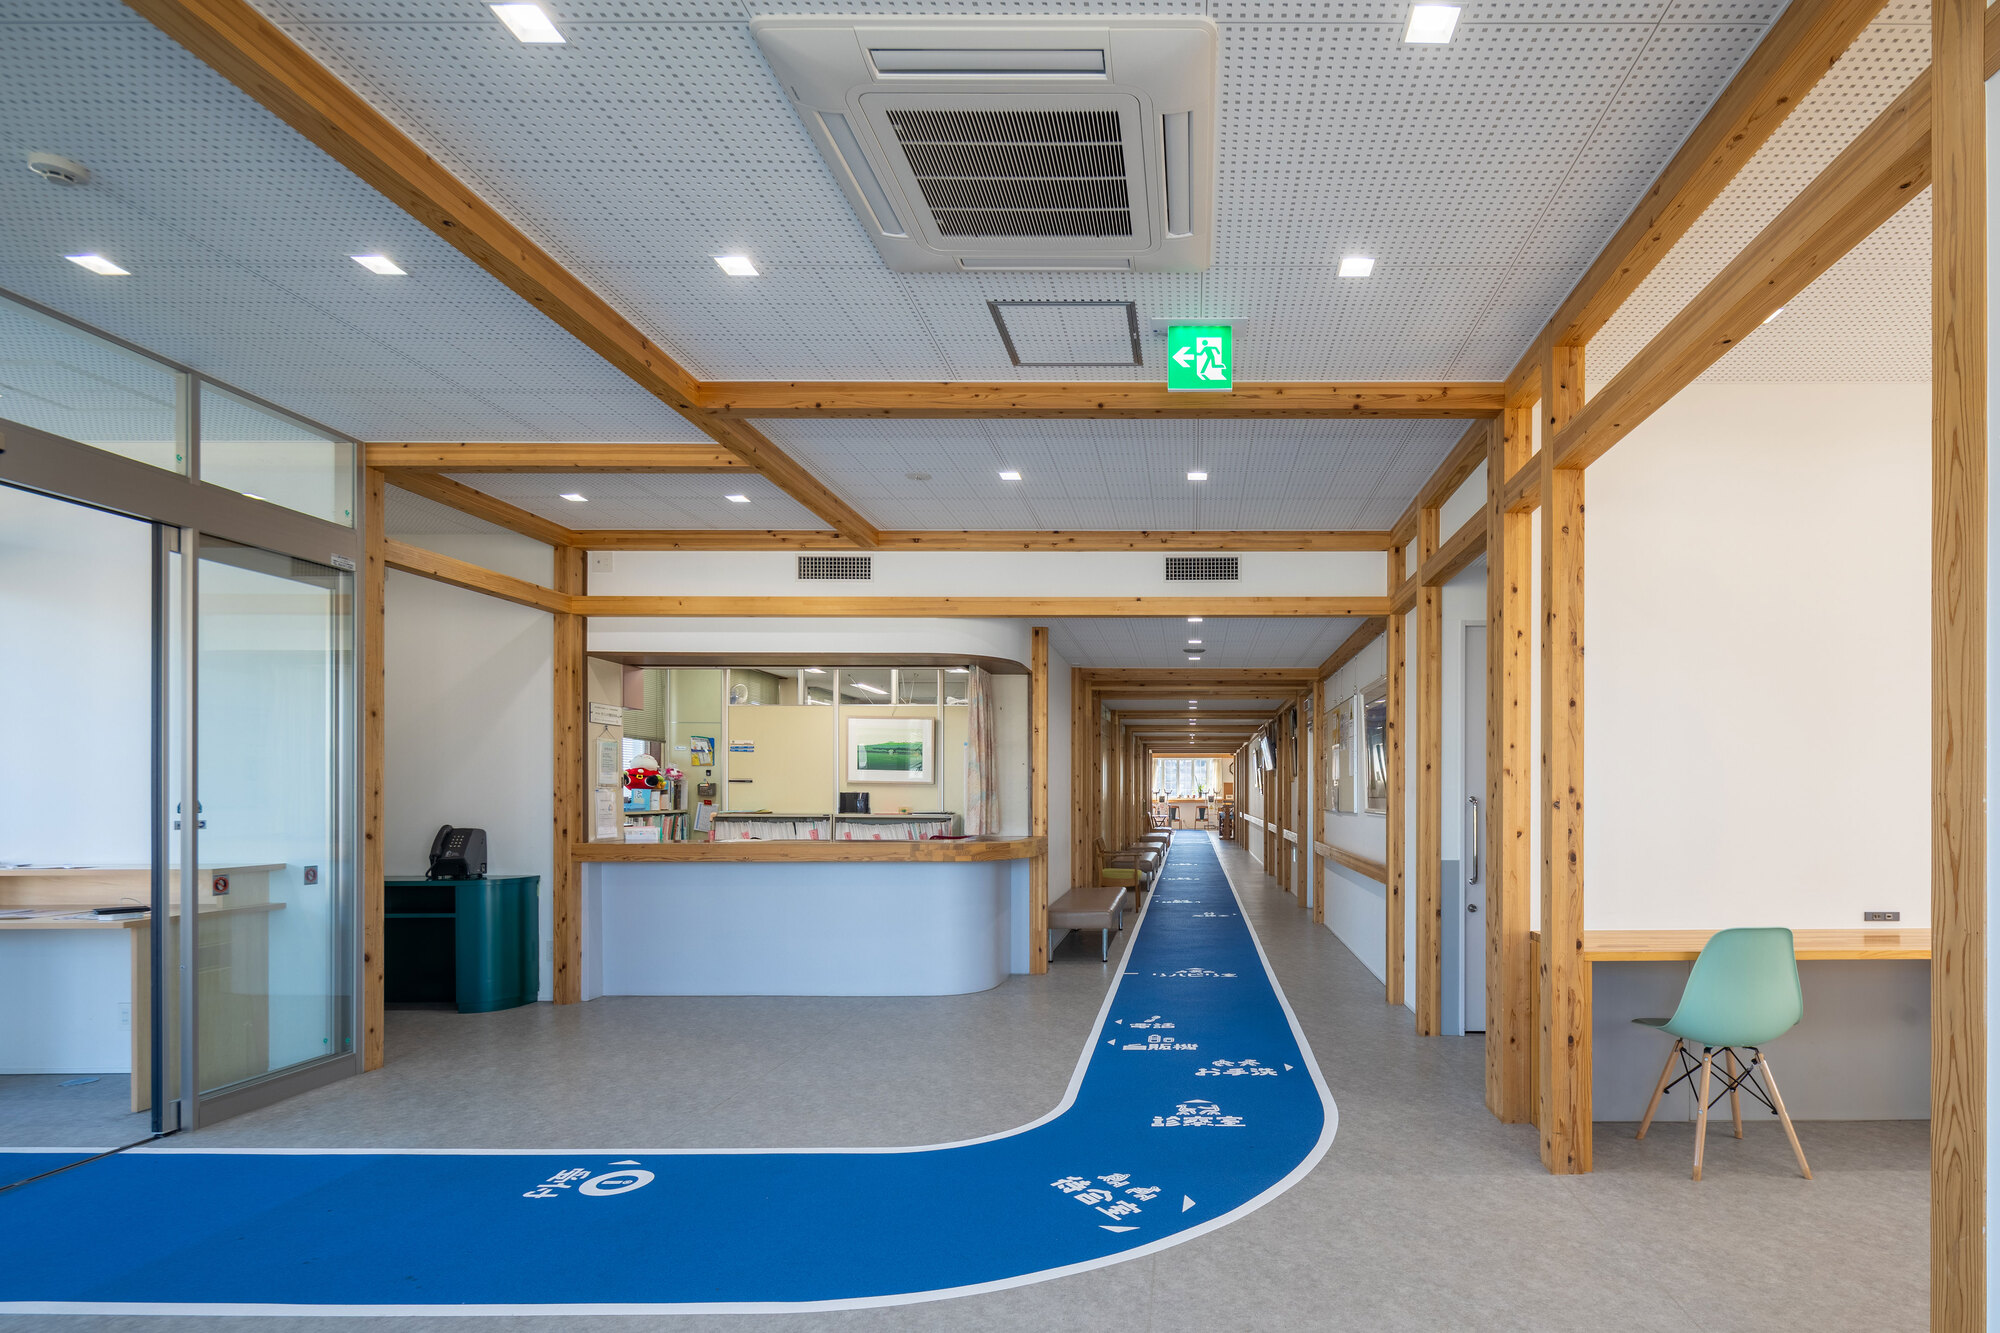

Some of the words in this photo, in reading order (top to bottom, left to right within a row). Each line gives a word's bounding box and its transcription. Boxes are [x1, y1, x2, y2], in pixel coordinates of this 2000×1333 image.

[1122, 1043, 1199, 1051] 自販機
[1194, 1067, 1278, 1076] お手洗
[1150, 1115, 1247, 1127] 診察室
[522, 1168, 592, 1199] 受付
[1050, 1176, 1142, 1221] 待合室
